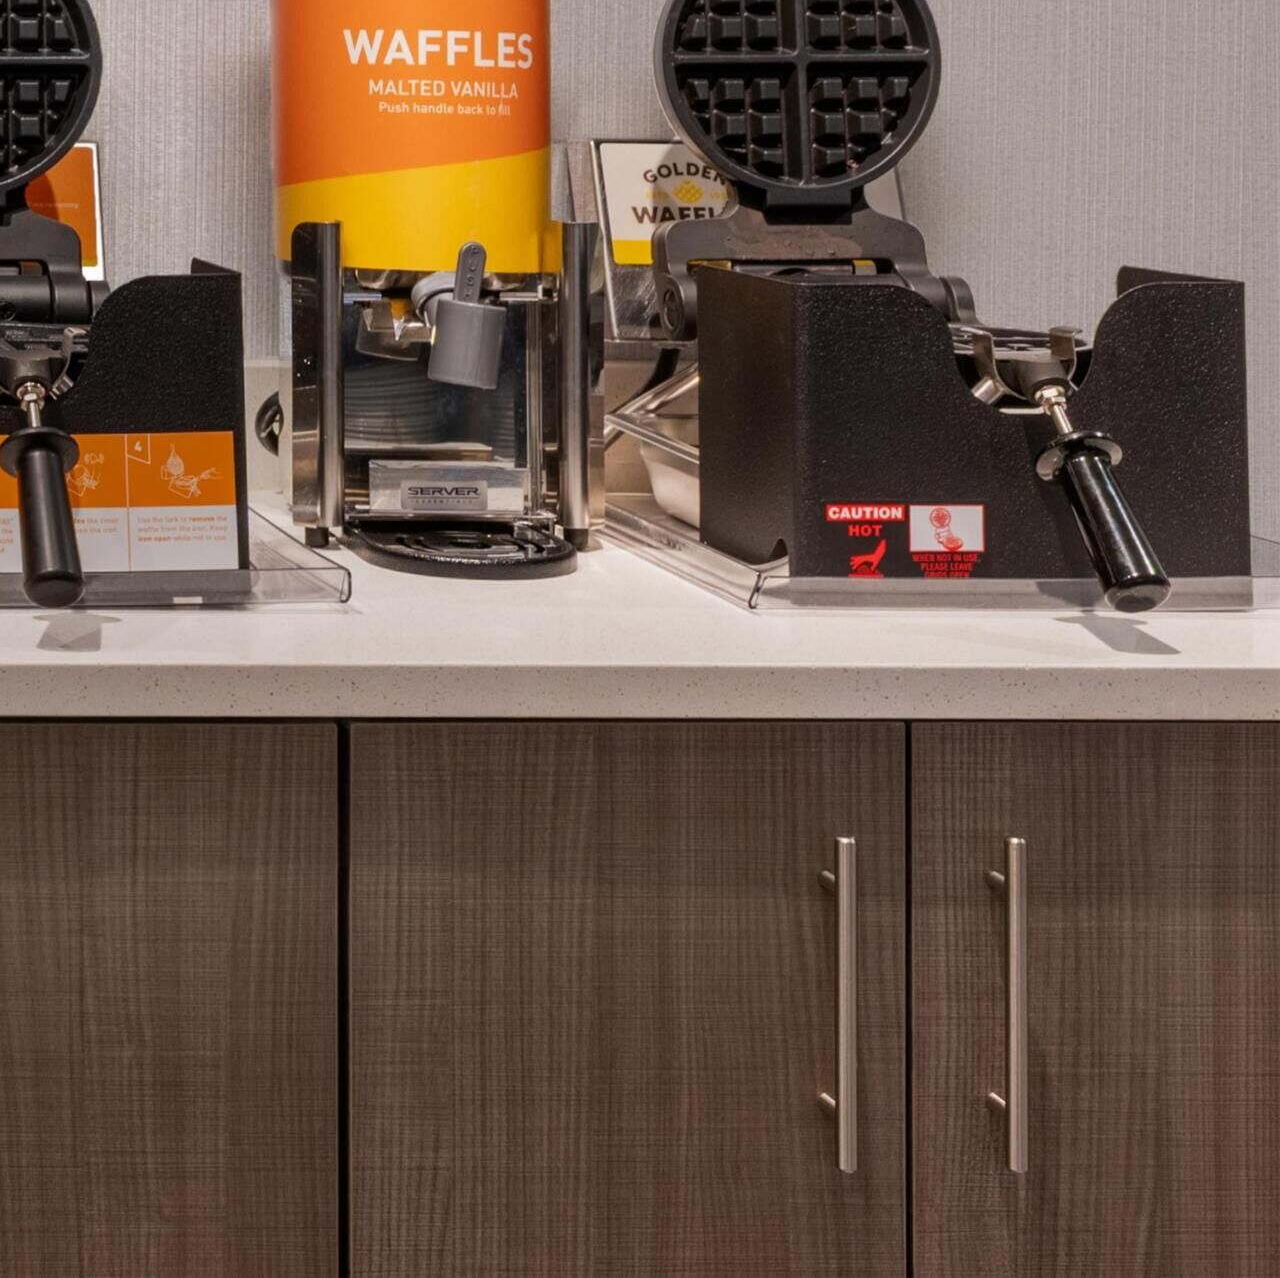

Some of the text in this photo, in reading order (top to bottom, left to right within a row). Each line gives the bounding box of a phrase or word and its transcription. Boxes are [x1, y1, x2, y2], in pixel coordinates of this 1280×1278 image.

[343, 28, 533, 69] WAFFLES
[369, 79, 519, 99] MALTED VANILLA
[379, 101, 511, 116] Push handle back to fill
[643, 162, 726, 186] GOLDEN
[134, 441, 142, 452] 4
[407, 485, 481, 496] SERVER
[827, 507, 903, 520] CAUTION
[848, 525, 883, 537] HOT
[912, 554, 936, 563] WHEN
[937, 554, 952, 563] NOT
[953, 554, 961, 563] IN
[921, 563, 973, 571] PLEASE LEAVE
